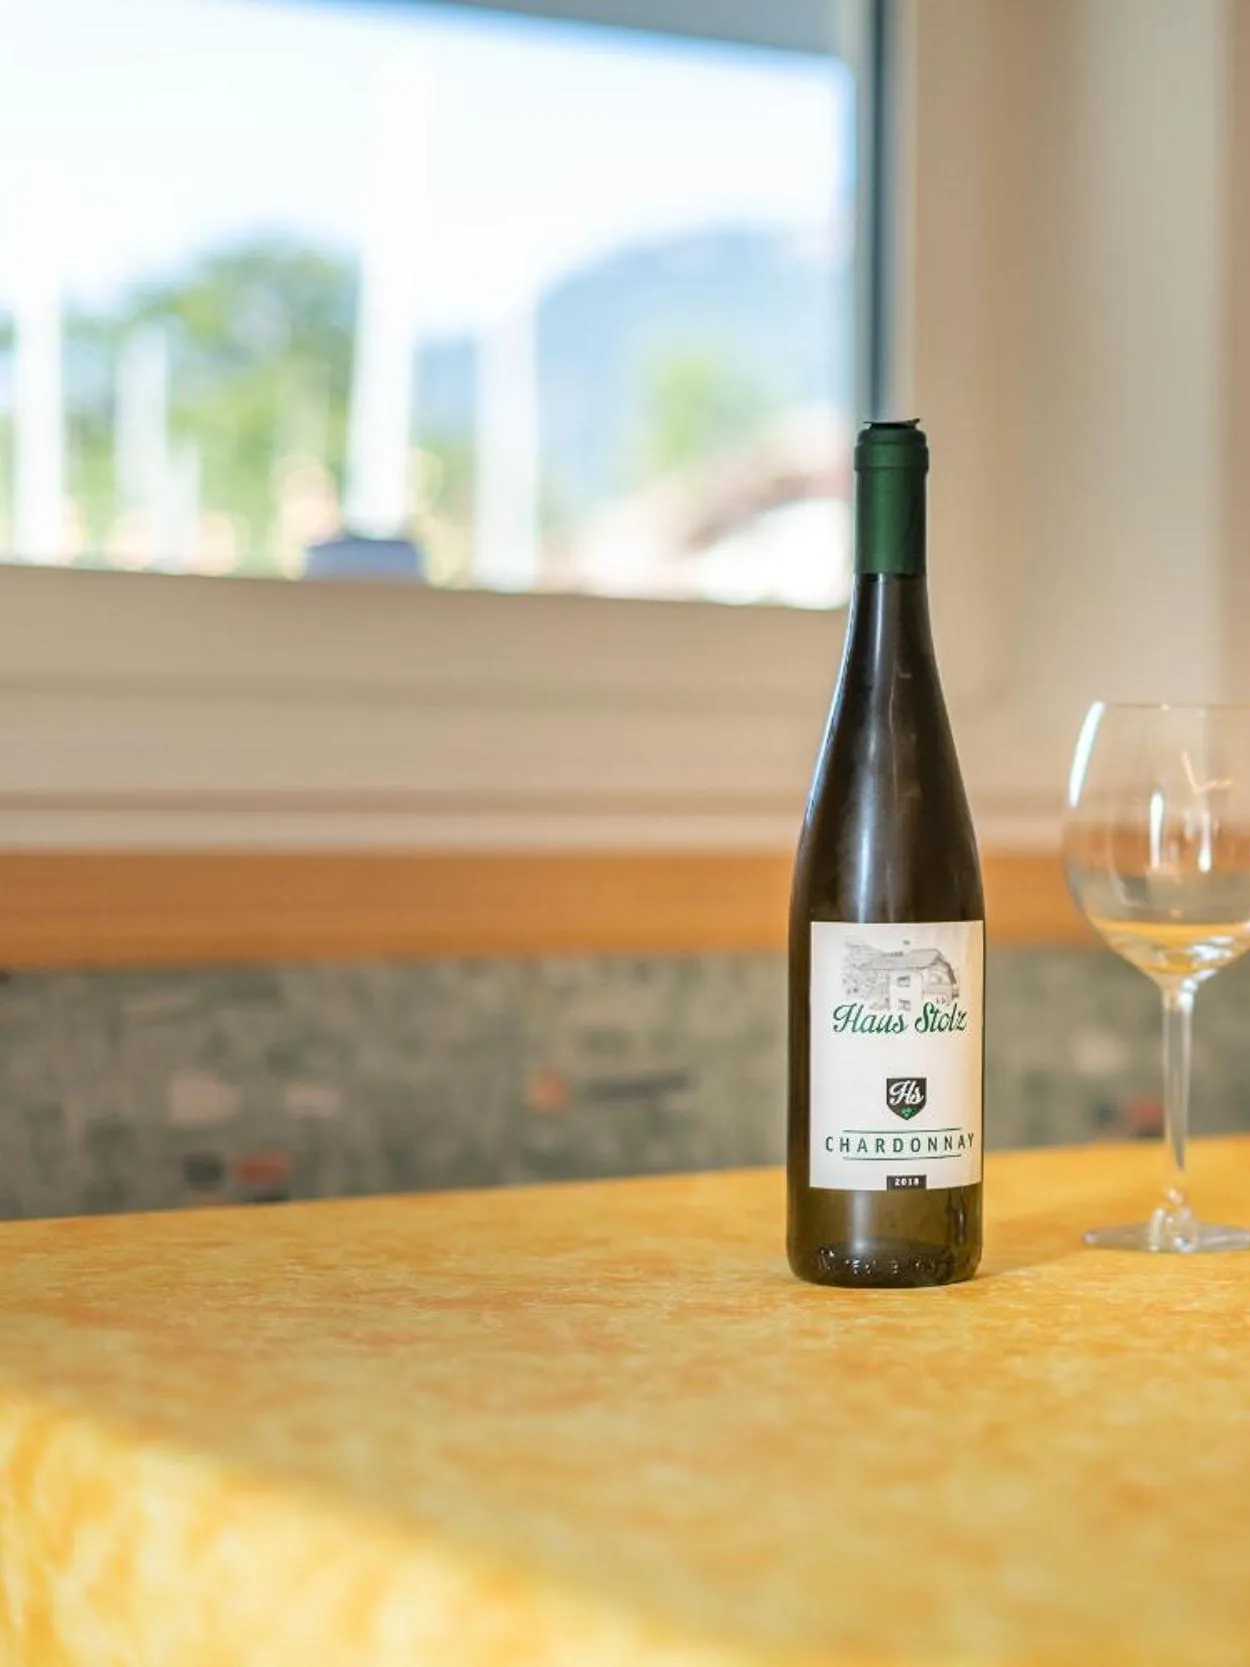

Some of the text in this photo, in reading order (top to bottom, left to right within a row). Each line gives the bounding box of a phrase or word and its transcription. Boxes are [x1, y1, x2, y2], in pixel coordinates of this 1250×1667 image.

[832, 1002, 968, 1034] Haus Stolz
[889, 1080, 925, 1105] Hs
[825, 1133, 975, 1153] CHARDONNAY
[894, 1177, 919, 1187] 2018
